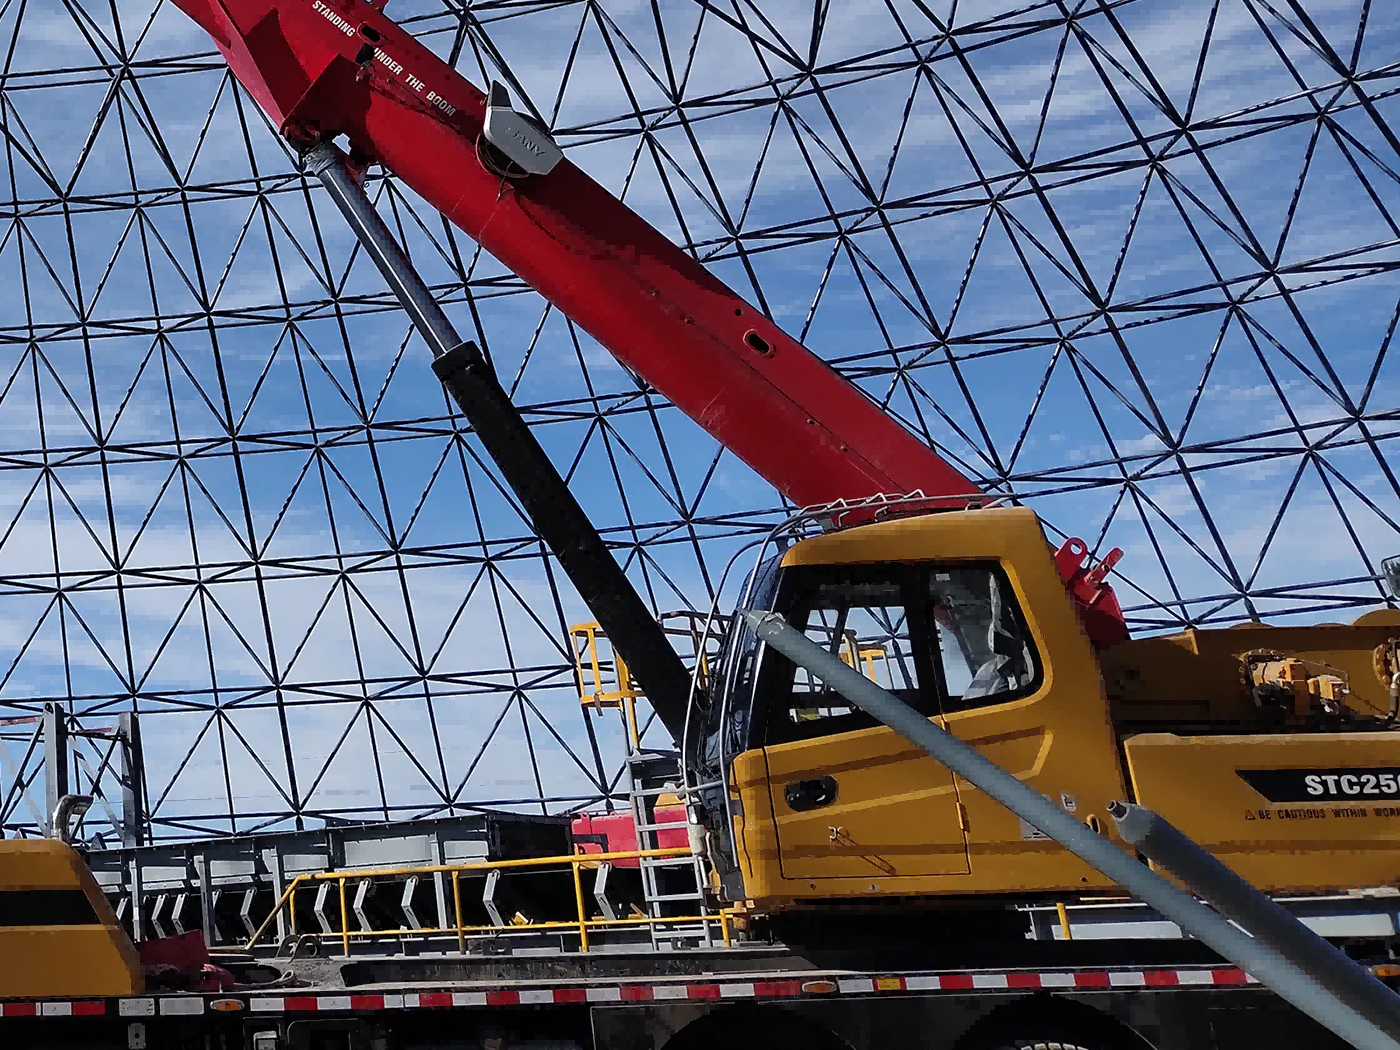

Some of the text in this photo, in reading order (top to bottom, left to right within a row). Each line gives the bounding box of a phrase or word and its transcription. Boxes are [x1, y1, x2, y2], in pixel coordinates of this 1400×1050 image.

[312, 0, 355, 37] STANDING
[374, 47, 403, 75] UNDER
[405, 73, 425, 92] THE
[426, 91, 456, 116] BOOM
[1305, 774, 1400, 795] STC25
[1259, 809, 1271, 820] BE
[1332, 807, 1367, 818] WITHIN
